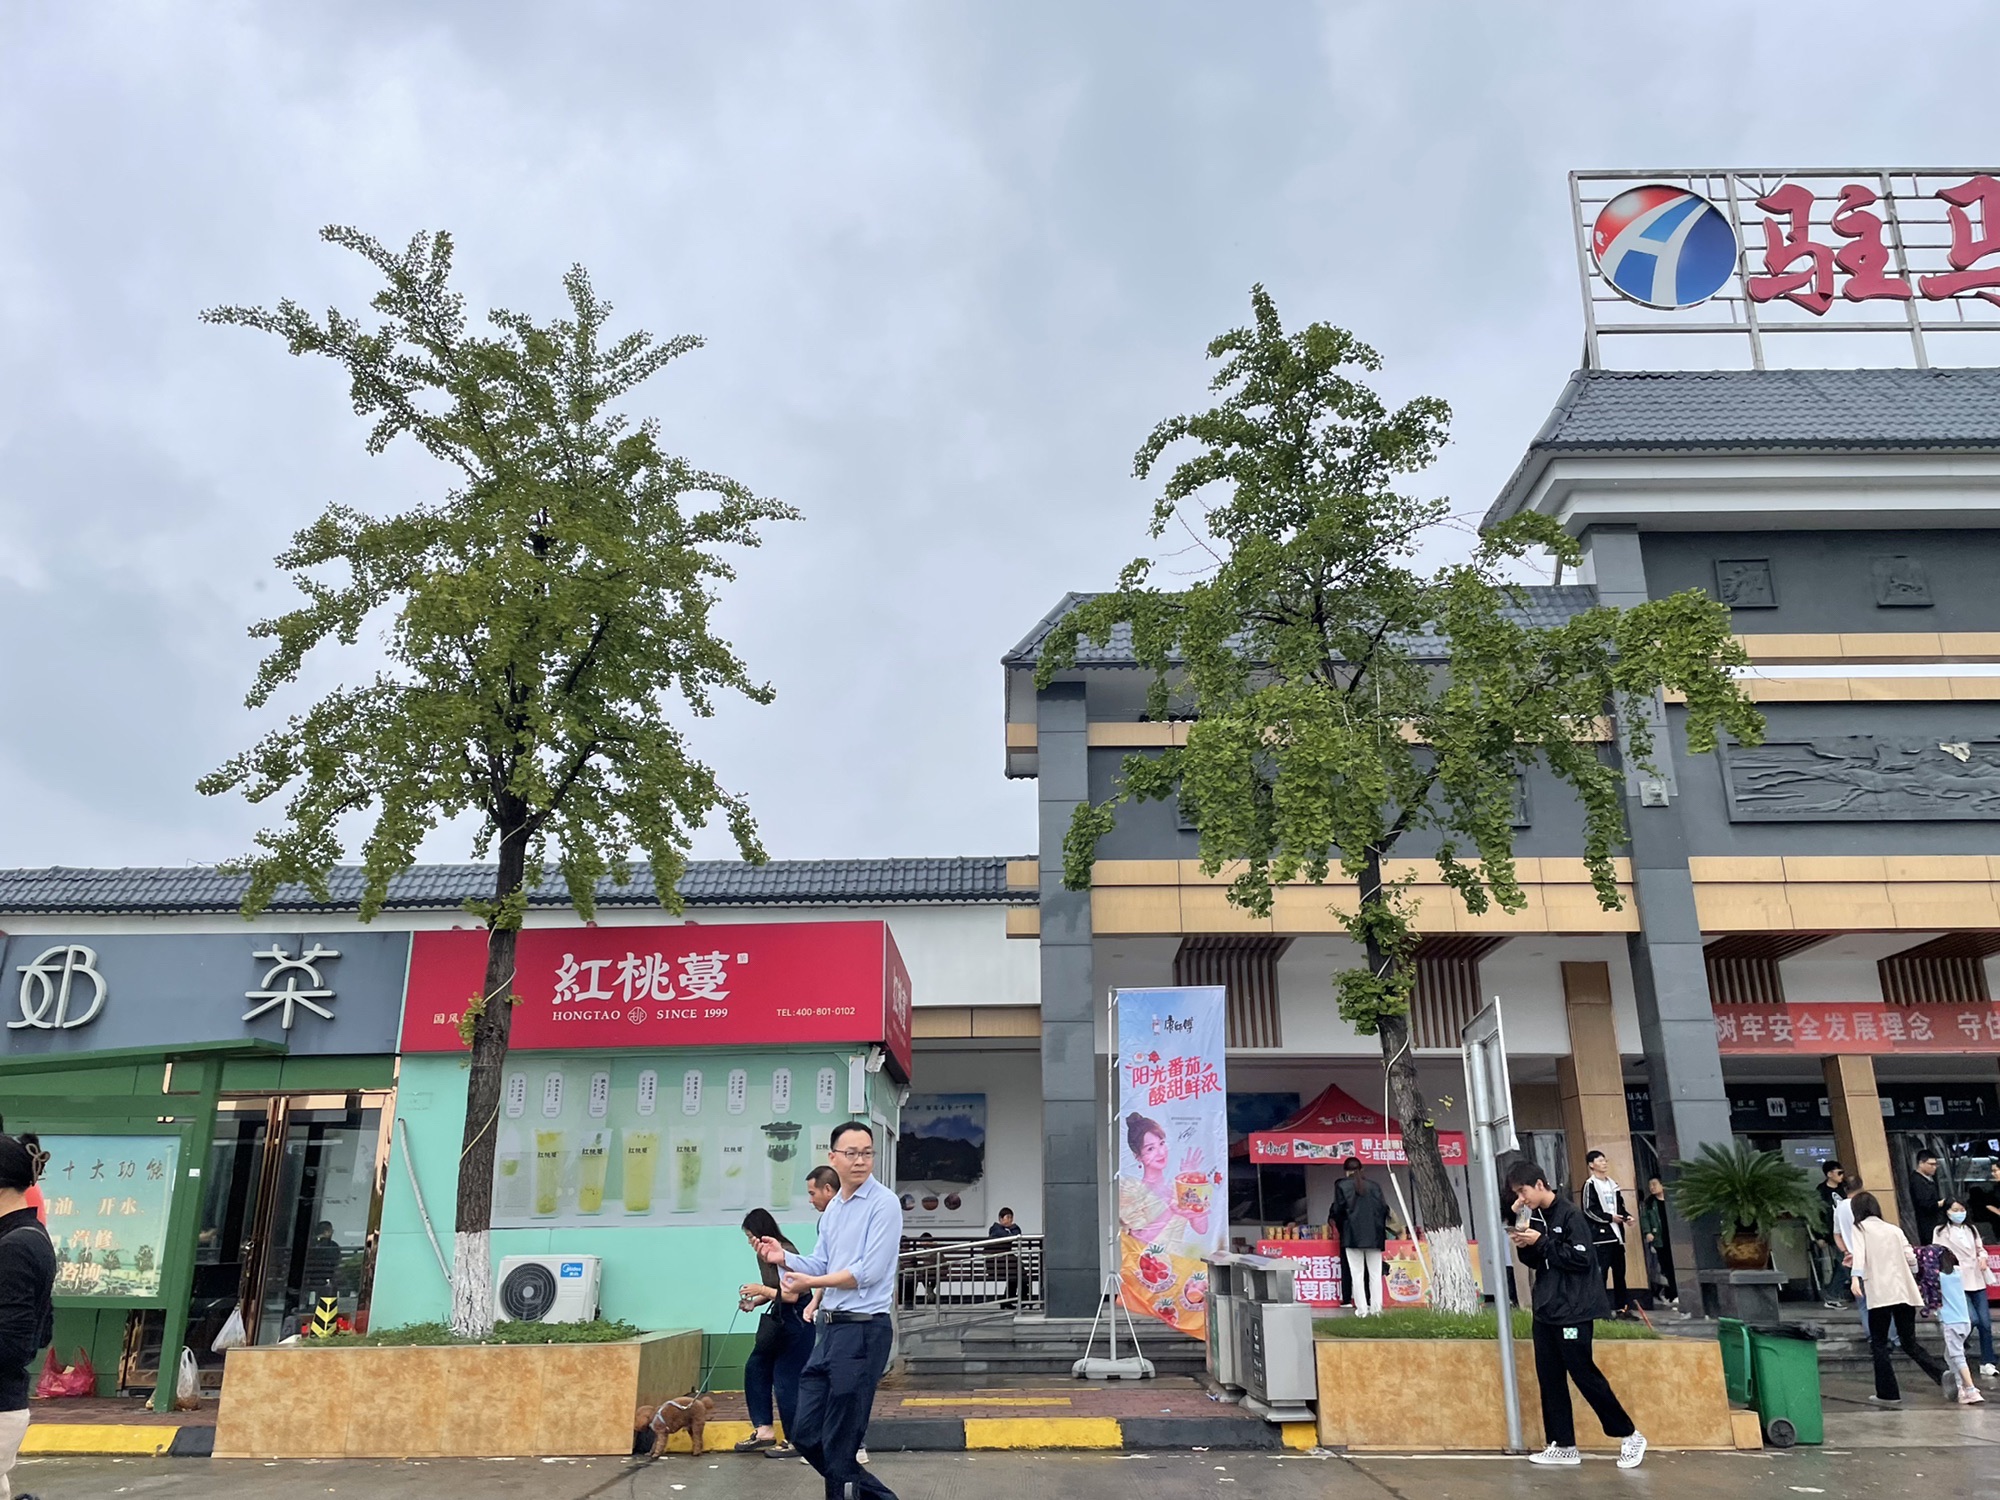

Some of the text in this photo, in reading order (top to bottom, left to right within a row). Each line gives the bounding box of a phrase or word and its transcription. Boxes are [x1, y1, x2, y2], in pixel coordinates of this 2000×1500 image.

[552, 1010, 621, 1021] HONGTAO
[656, 1009, 698, 1019] SINCE
[703, 1008, 728, 1018] 1999
[1713, 1012, 1935, 1042] 树牢安全发展理念
[1132, 1056, 1201, 1089] 阳光番茄
[1148, 1072, 1222, 1107] 酸甜鲜浓
[1361, 1138, 1404, 1150] 带上康师
